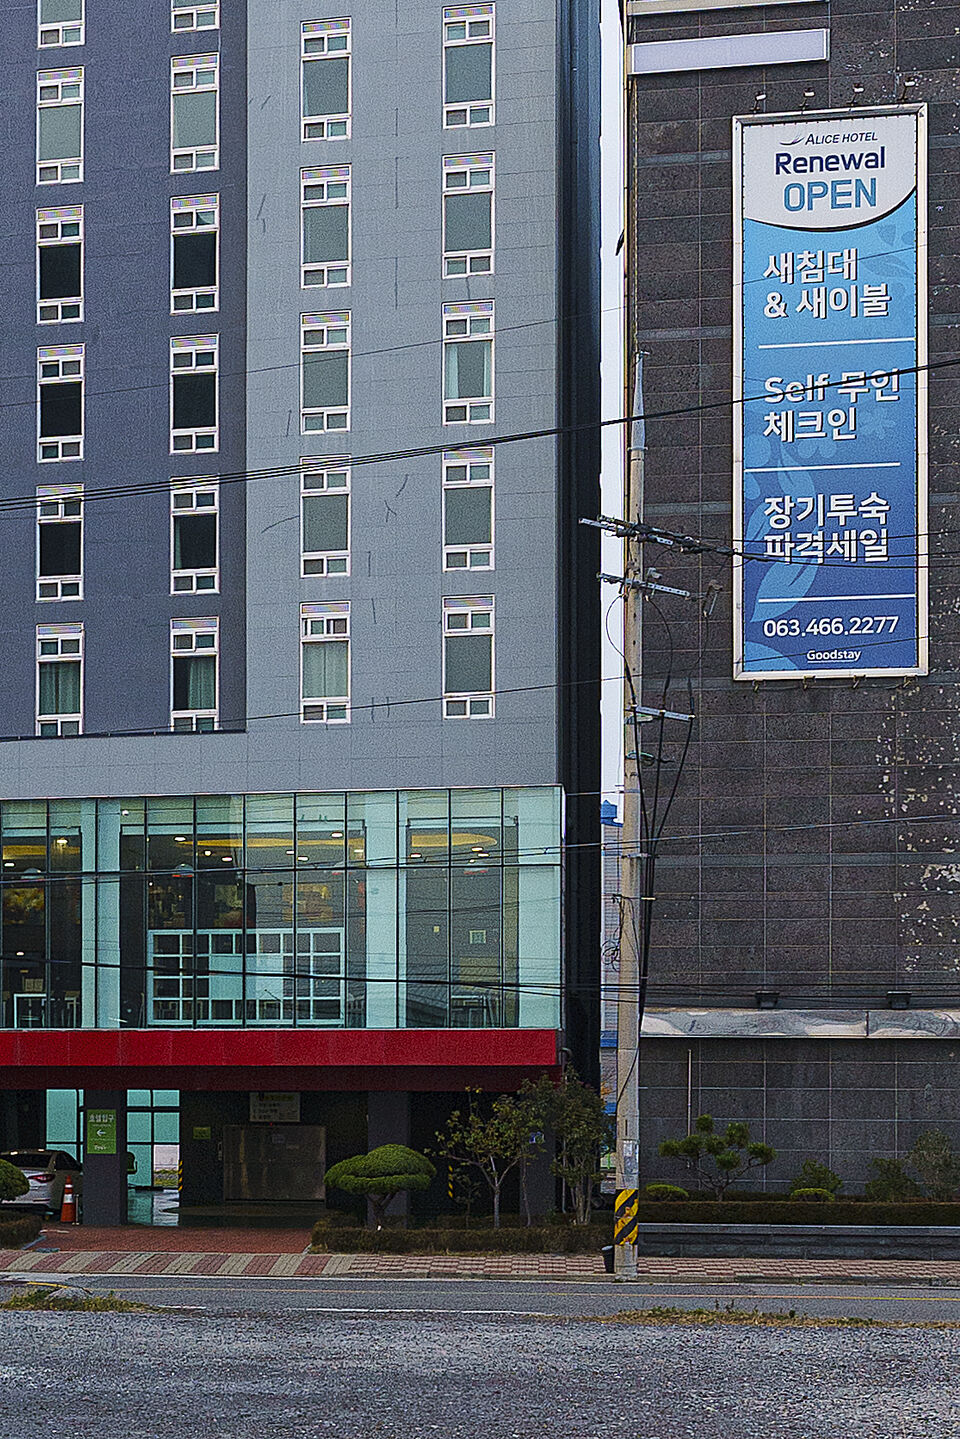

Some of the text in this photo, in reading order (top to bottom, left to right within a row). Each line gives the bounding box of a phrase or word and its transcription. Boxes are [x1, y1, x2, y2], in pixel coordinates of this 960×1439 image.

[805, 132, 878, 145] ALICE HOTEL
[775, 146, 886, 175] Renewal
[783, 177, 877, 212] OPEN
[763, 248, 858, 284] 새침대
[763, 283, 892, 319] & 새이불
[764, 368, 901, 403] Self 무인
[763, 406, 857, 442] 체크인
[763, 492, 890, 529] 장기투숙
[763, 528, 889, 565] 파격세일
[763, 616, 899, 637] 063.466.2277
[806, 649, 862, 662] Goodstay
